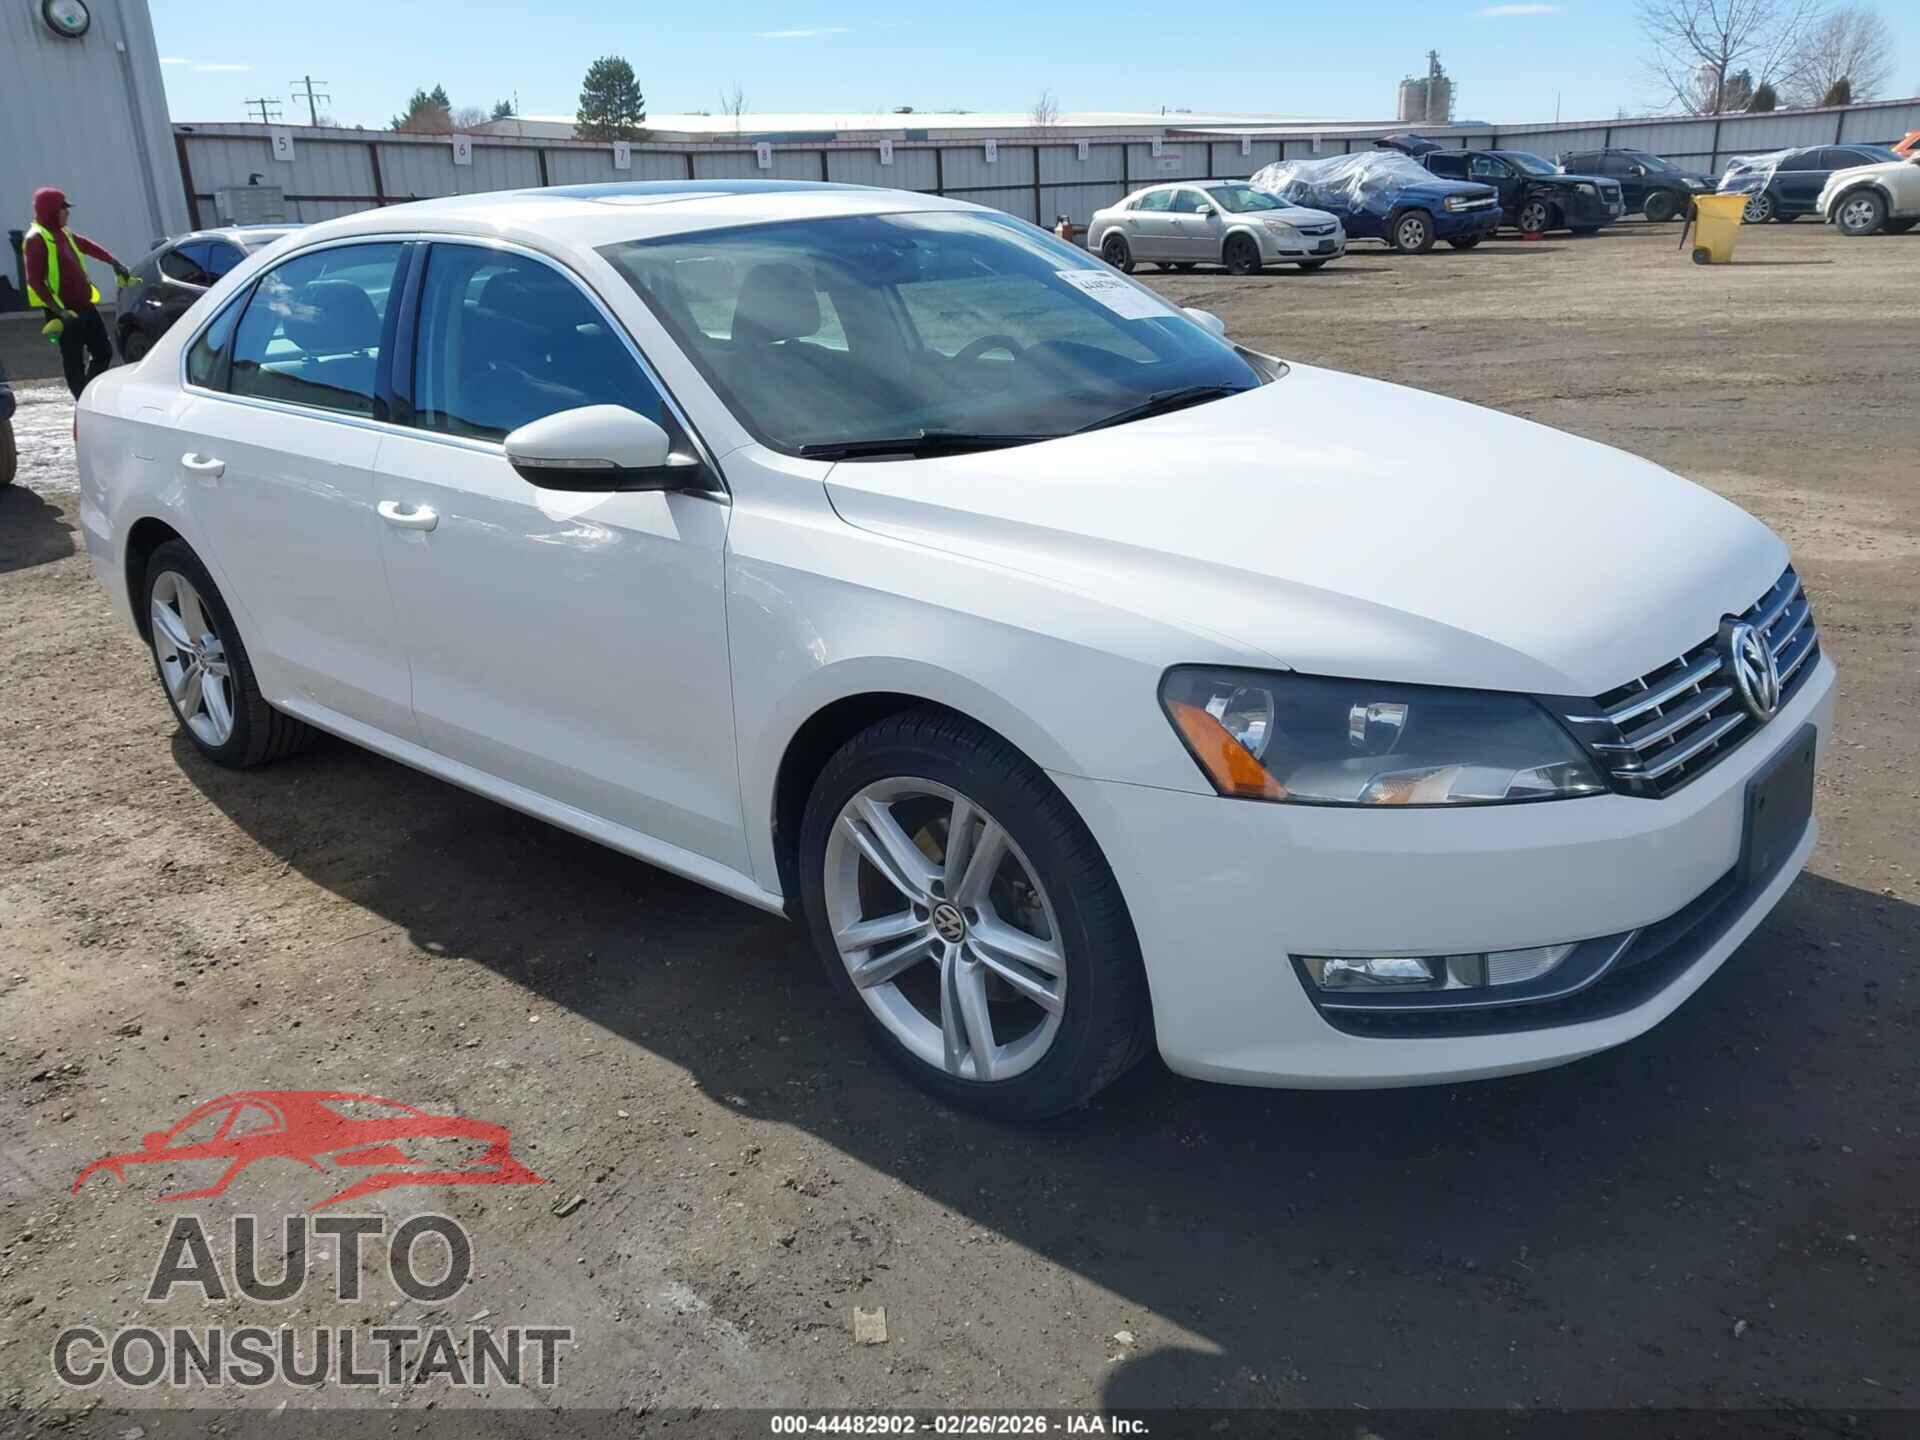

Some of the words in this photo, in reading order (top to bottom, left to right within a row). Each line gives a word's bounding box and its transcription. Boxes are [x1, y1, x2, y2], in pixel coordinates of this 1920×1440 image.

[278, 136, 287, 151] 5
[458, 143, 467, 157] 6
[618, 148, 626, 161] 7
